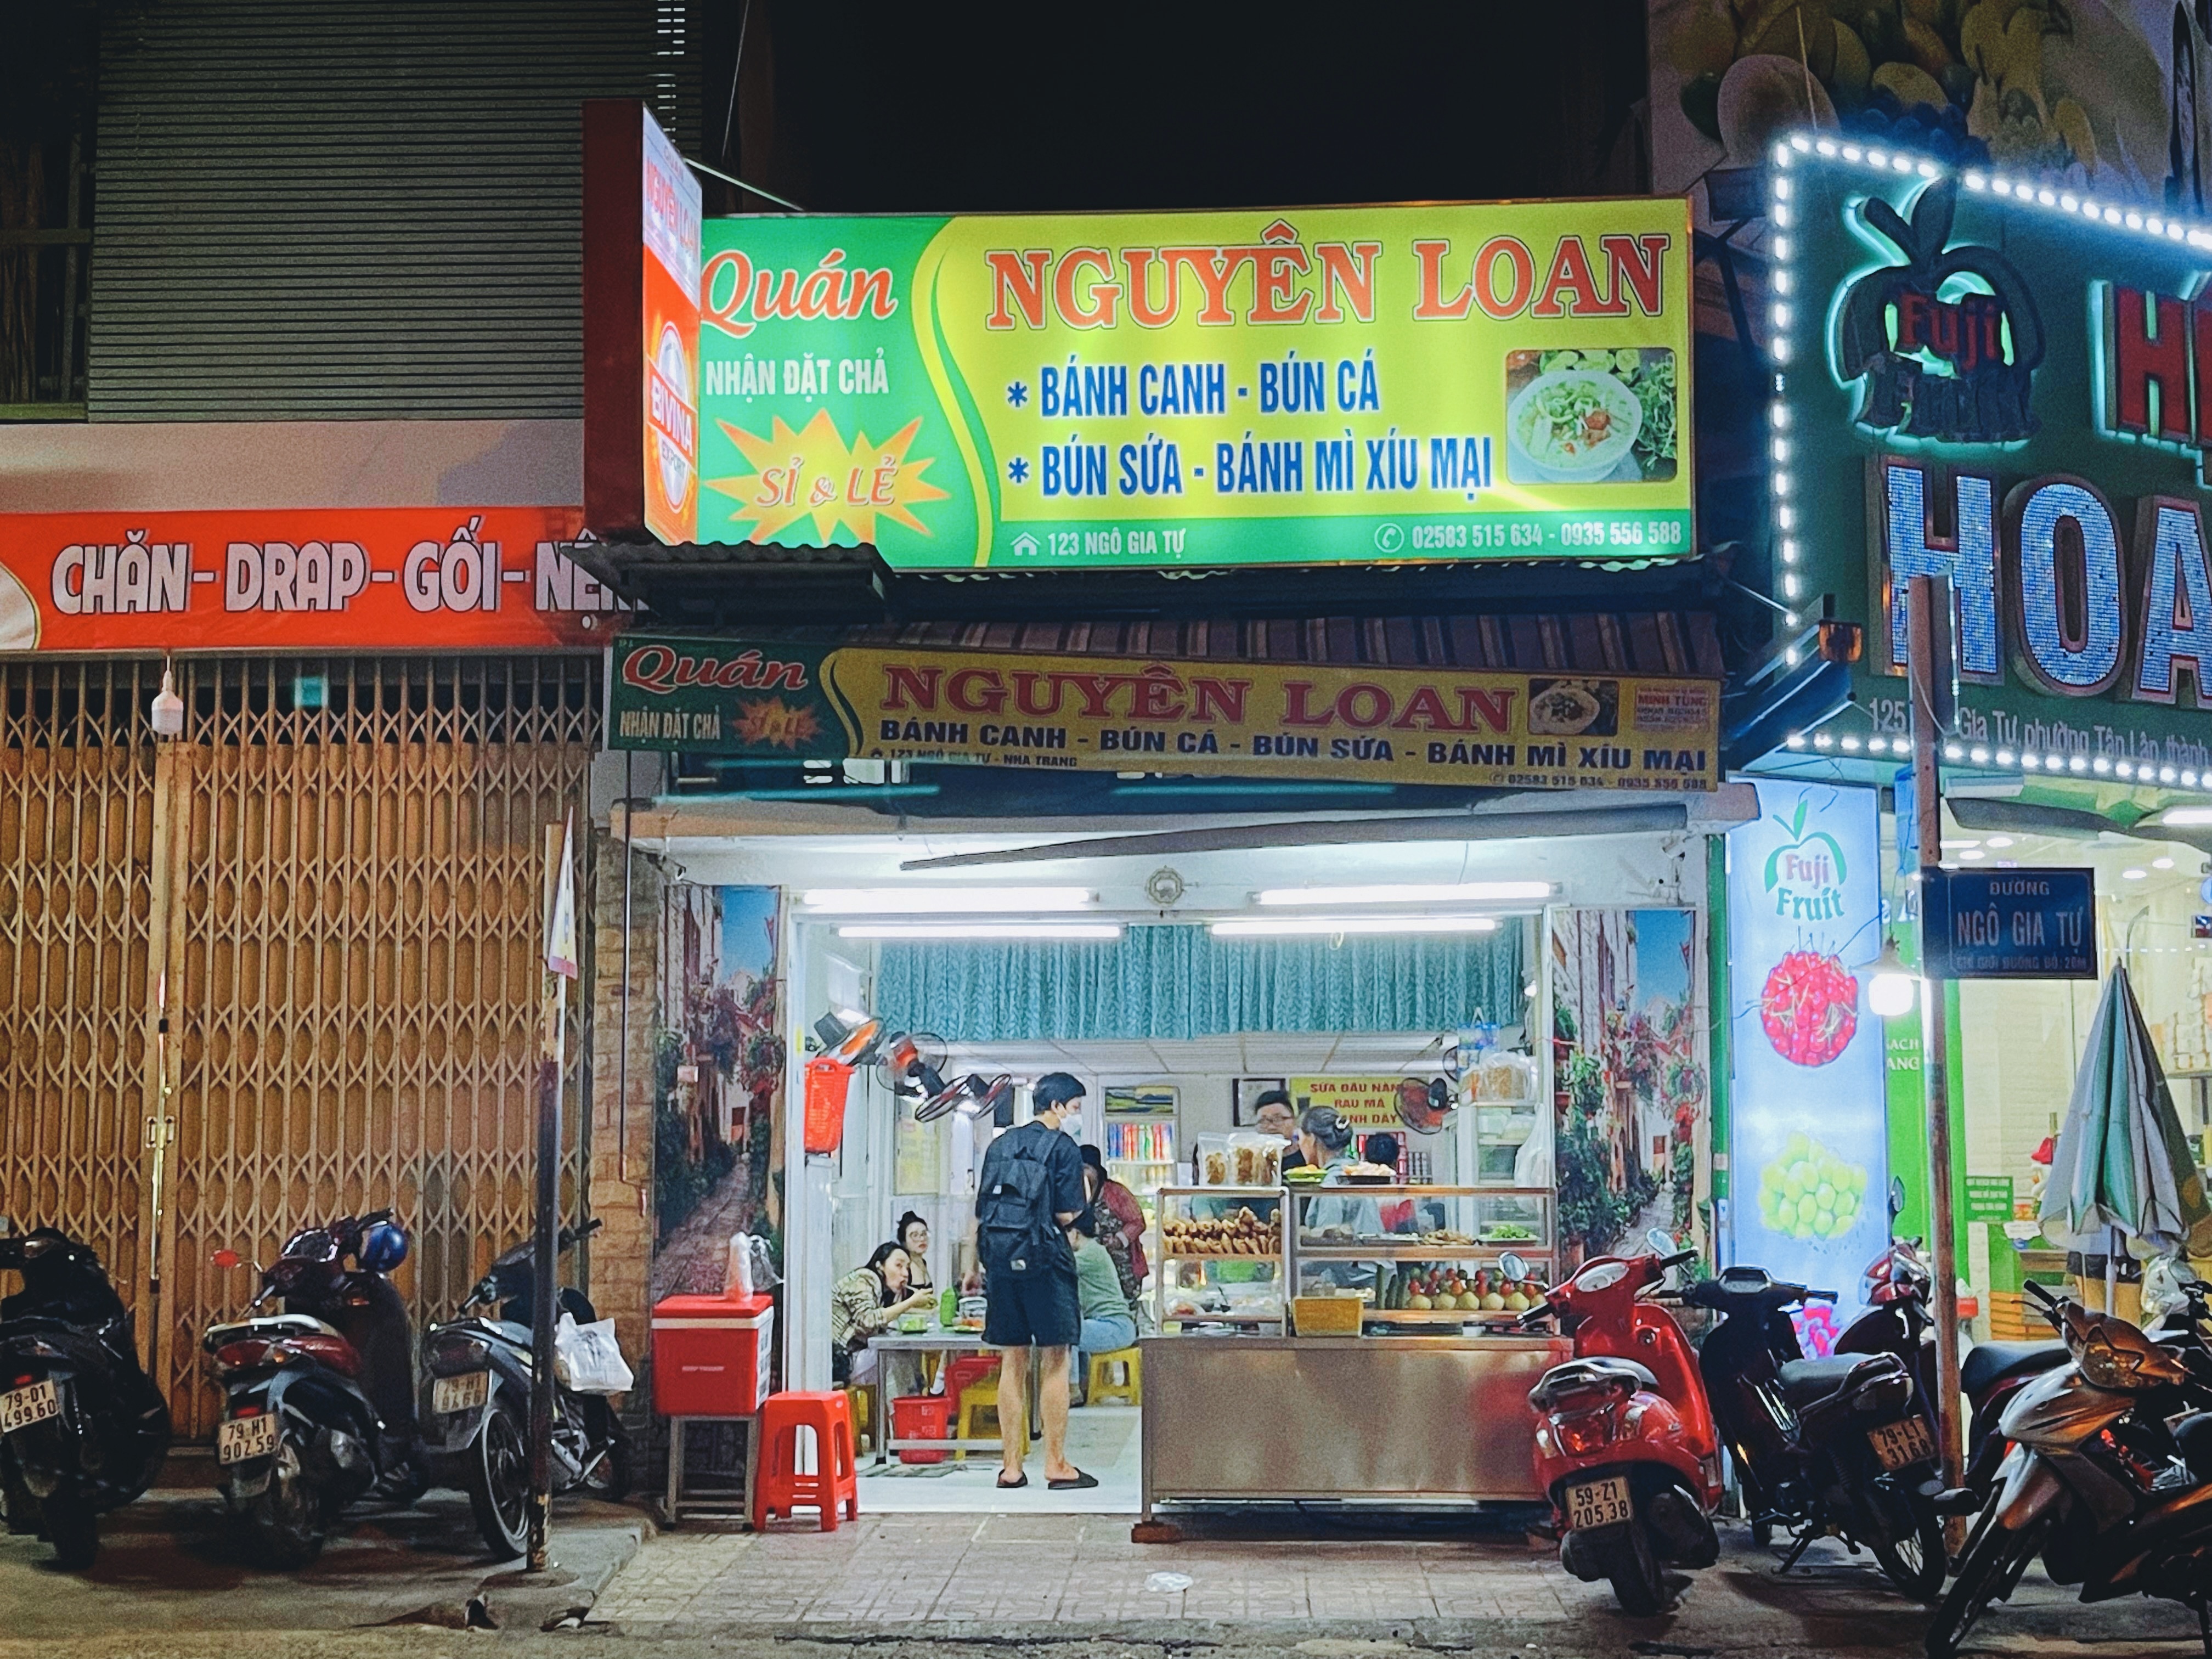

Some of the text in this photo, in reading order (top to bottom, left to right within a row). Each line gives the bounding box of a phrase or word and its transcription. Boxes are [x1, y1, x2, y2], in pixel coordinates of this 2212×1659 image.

[701, 248, 899, 339] Quán
[985, 219, 1671, 330] NGUYÊN LOAN
[1899, 293, 1997, 371] Fuji
[706, 347, 889, 403] NHẬN ĐẶT CHẢ
[1041, 354, 1127, 416] BÁNH
[1140, 364, 1224, 415] CANH
[1261, 351, 1325, 413] BÚN
[1338, 348, 1380, 411] CÁ
[651, 375, 692, 457] BIVINA
[757, 455, 898, 507] SỈ & LẺ
[1043, 434, 1107, 495] BÚN
[1119, 432, 1182, 495] SỨA
[1217, 431, 1302, 493] BÁNH
[1316, 429, 1354, 491] MÌ
[1366, 428, 1418, 490] XÍU
[1430, 437, 1491, 501] MẠI
[1048, 527, 1186, 558] 123 NGÔ GIA TỰ
[1412, 525, 1466, 549] 02583
[1472, 524, 1506, 547] 515
[1510, 523, 1543, 546] 634
[1561, 522, 1605, 546] 0935
[1610, 522, 1643, 545] 556
[1648, 521, 1681, 544] 588
[536, 528, 650, 629] NỆ
[1882, 454, 2212, 708] HOA
[623, 645, 808, 695] Quán
[879, 662, 1519, 733] NGUYÊN LOAN
[1870, 697, 1907, 732] 125
[1959, 707, 1989, 741] Gia
[619, 704, 720, 745] NHẬN ĐẶT CHẢ
[881, 716, 968, 744] BÁNH
[980, 724, 1066, 749] CANH
[1101, 726, 1166, 753] BÚN
[1177, 729, 1219, 754] CÁ
[1253, 732, 1318, 758] BÚN
[1330, 735, 1393, 761] SỨA
[1427, 739, 1516, 766] BÁNH
[1527, 742, 1566, 766] MÌ
[1578, 743, 1631, 768] XÍU
[1643, 749, 1706, 775] MẠI
[1003, 754, 1031, 766] NHA
[1035, 755, 1077, 768] TRANG
[1786, 854, 1829, 889] Fuji
[1990, 879, 2050, 895] ĐƯỜNG
[1776, 887, 1844, 921] Fruit
[1957, 902, 1999, 946] NGÔ
[2012, 911, 2045, 946] GIA
[2056, 906, 2084, 953] TỰ
[1310, 1082, 1336, 1093] SỮA
[1334, 1099, 1359, 1108] RAU
[1573, 1500, 1628, 1528] 205.38
[1576, 1481, 1618, 1506] 59-Z1
